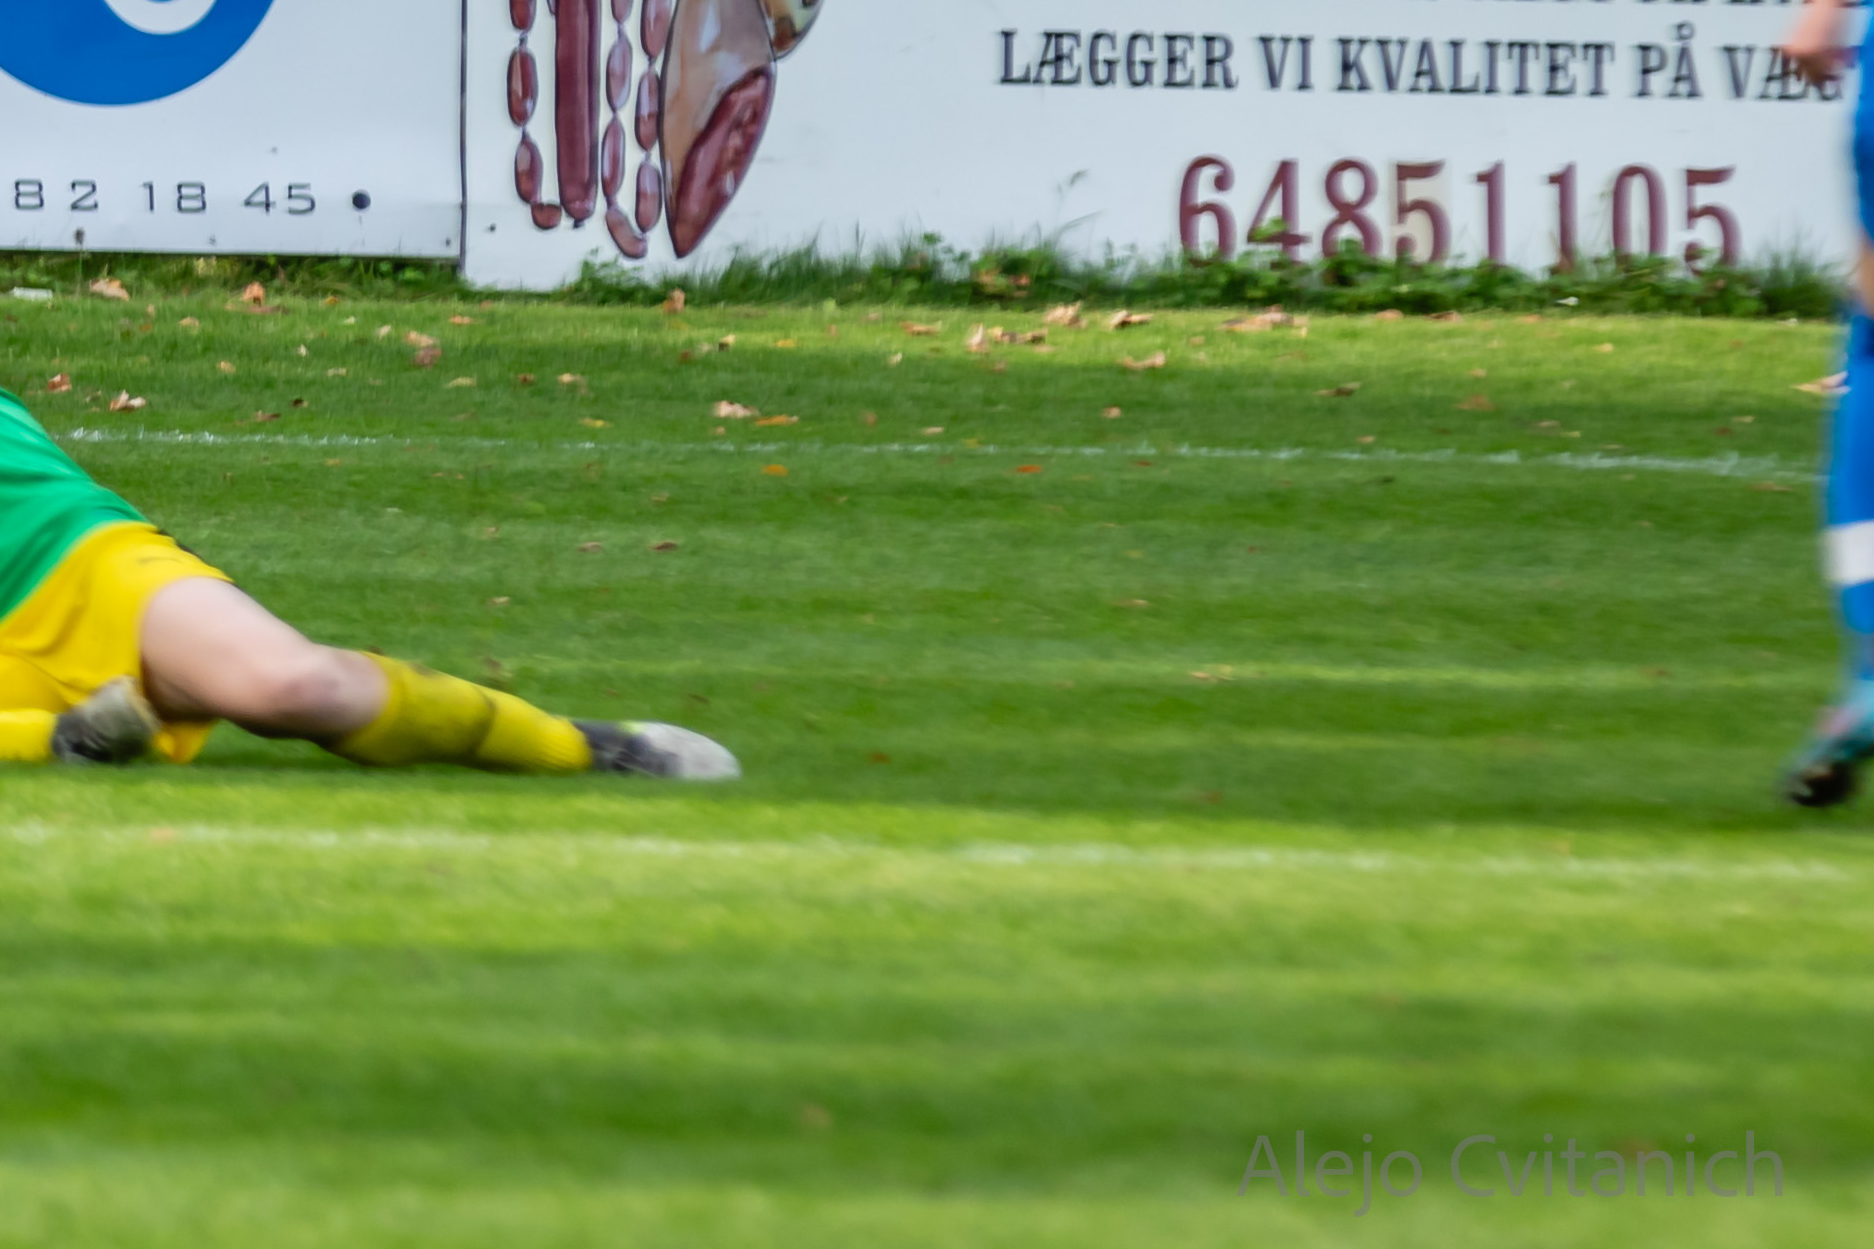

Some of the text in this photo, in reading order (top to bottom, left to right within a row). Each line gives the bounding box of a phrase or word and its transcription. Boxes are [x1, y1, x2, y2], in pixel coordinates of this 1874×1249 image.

[999, 30, 1237, 90] LÆGGER
[1257, 35, 1314, 92] VI
[1335, 37, 1615, 98] KVALITET
[1634, 22, 1702, 100] PÅ
[14, 179, 99, 212] 82
[142, 181, 207, 214] 18
[243, 183, 316, 216] 45
[1179, 155, 1742, 272] 64851105
